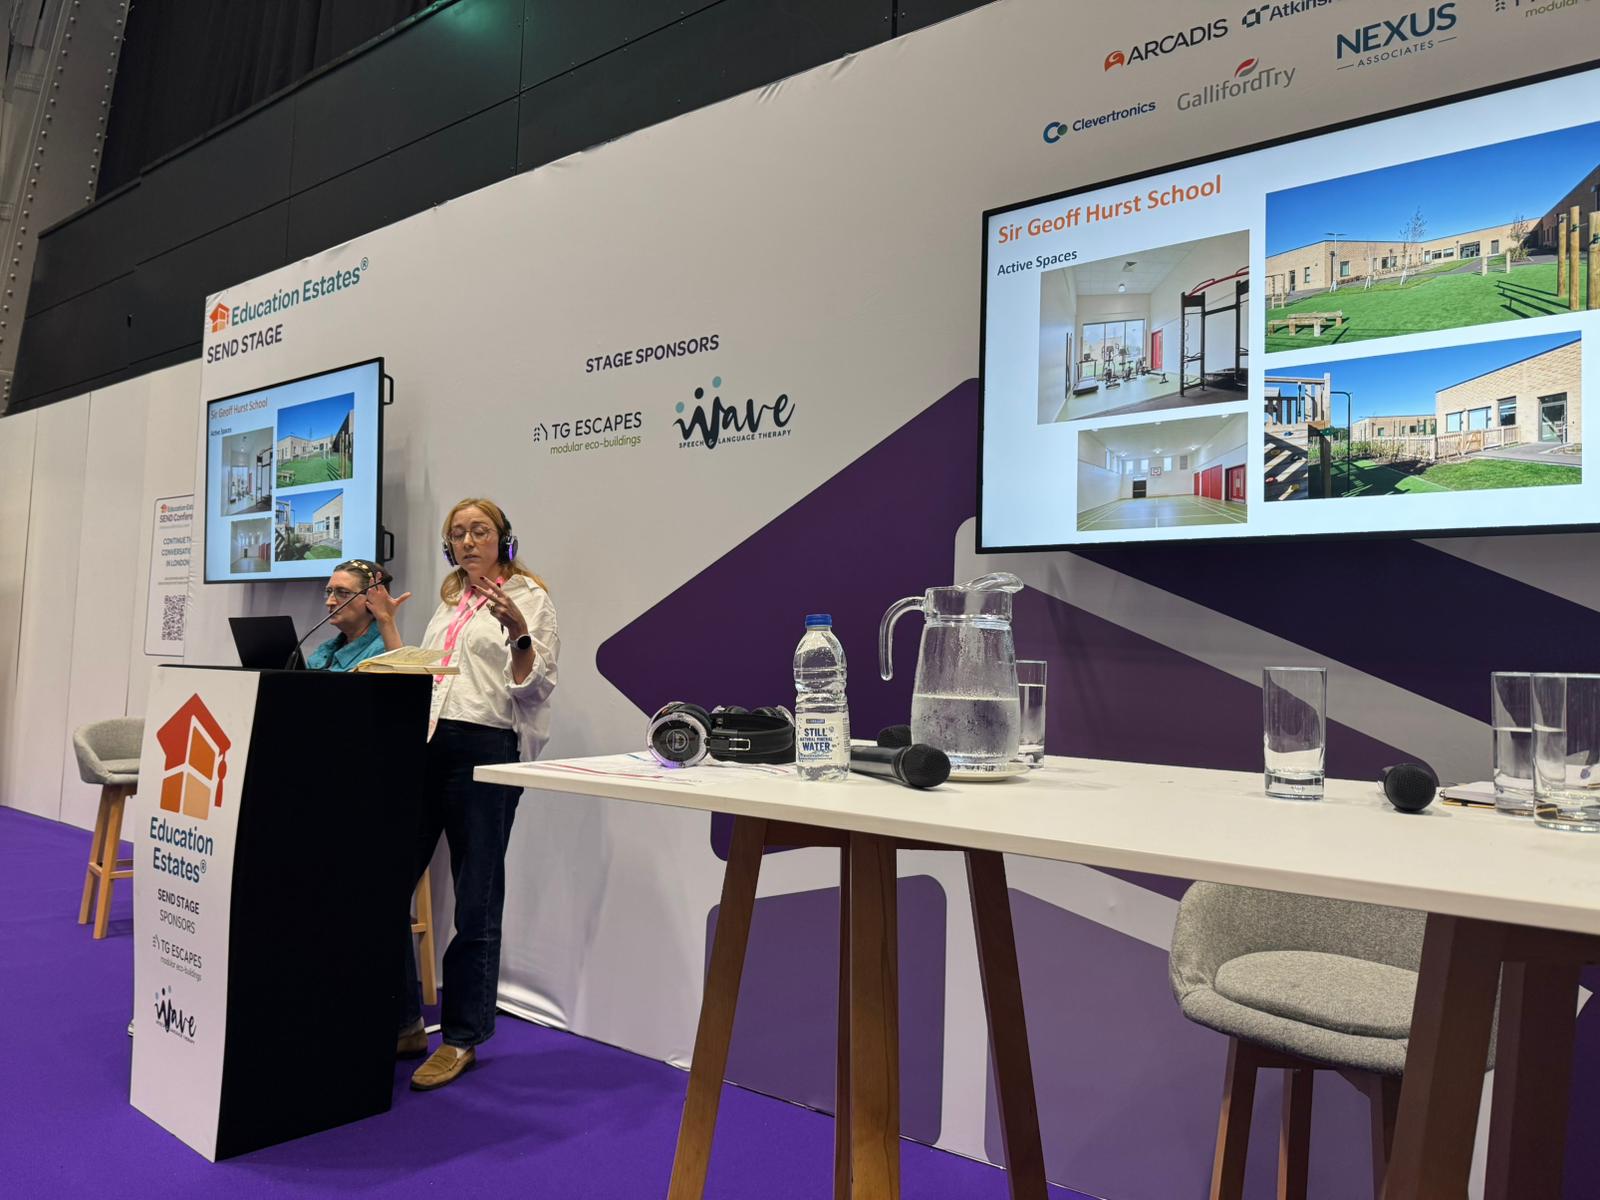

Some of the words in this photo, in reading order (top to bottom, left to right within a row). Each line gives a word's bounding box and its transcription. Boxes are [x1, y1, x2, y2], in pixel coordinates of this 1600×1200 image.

[1127, 19, 1229, 65] ARCADIS
[1337, 2, 1457, 59] NEXUS
[1357, 40, 1434, 67] ASSOCIATES
[1072, 101, 1156, 132] Clevertronics
[998, 224, 1022, 244] Sir
[1027, 207, 1081, 236] Geoff
[1086, 195, 1142, 223] Hurst
[1147, 174, 1222, 209] School
[997, 259, 1033, 276] Active
[1035, 250, 1078, 269] Spaces
[231, 288, 300, 326] Education
[207, 338, 239, 364] SEND
[241, 323, 284, 354] STAGE
[585, 350, 633, 373] STAGE
[635, 334, 720, 364] SPONSORS
[552, 422, 571, 439] TG
[575, 411, 642, 437] ESCAPES
[672, 393, 796, 450] Wave
[550, 442, 583, 455] modular
[585, 435, 642, 450] eco-buildings
[679, 441, 704, 449] SPEECH
[718, 433, 756, 445] LANGUAGE
[758, 429, 792, 440] THERAPY
[802, 742, 831, 751] WATER
[804, 727, 828, 737] STILL
[150, 816, 214, 856] Education
[157, 888, 176, 905] SEND
[176, 895, 200, 915] STAGE
[160, 909, 196, 935] SPONSORS
[161, 939, 171, 954] TG
[171, 943, 202, 969] ESCAPES
